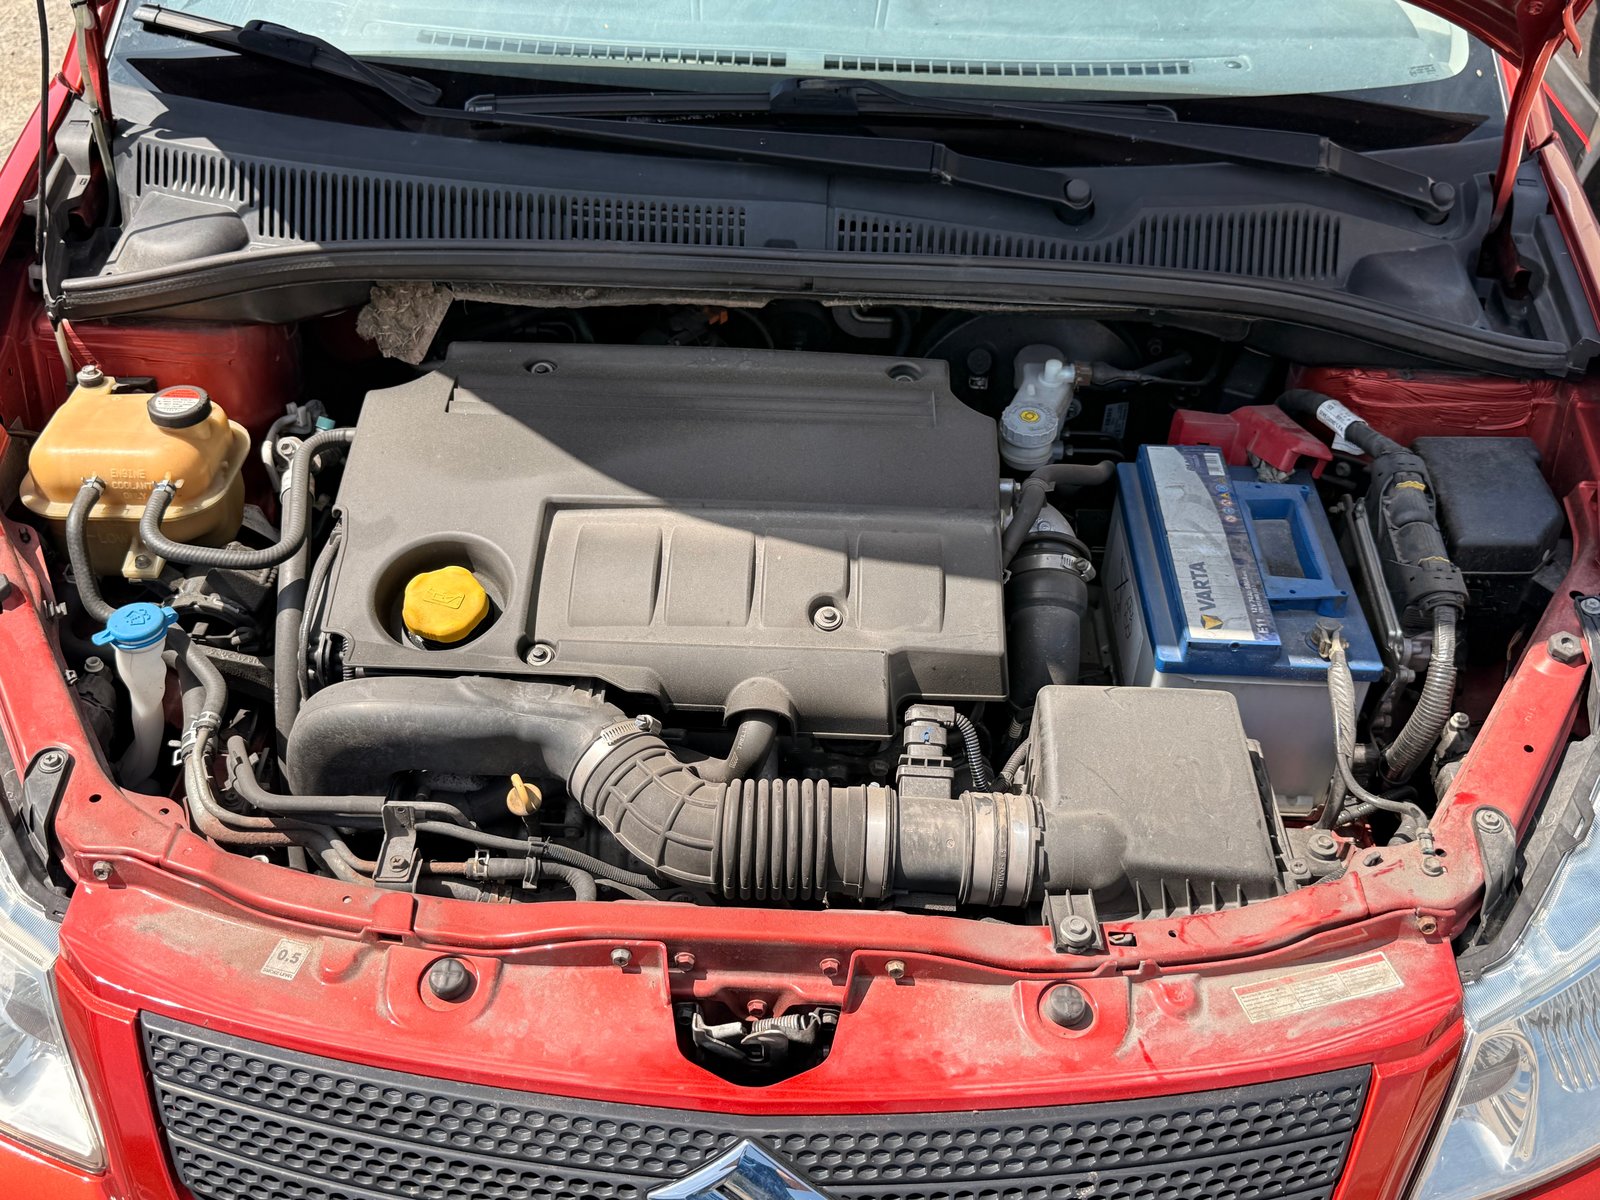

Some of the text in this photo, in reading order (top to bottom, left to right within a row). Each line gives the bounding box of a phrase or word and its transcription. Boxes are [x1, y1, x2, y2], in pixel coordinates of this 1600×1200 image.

[110, 468, 146, 479] ENGINE
[111, 480, 153, 490] COOLANT
[1189, 562, 1216, 611] VARTA
[1256, 618, 1269, 634] E11
[277, 949, 302, 964] 0.5
[263, 968, 294, 979] SMOKE LEVEL
